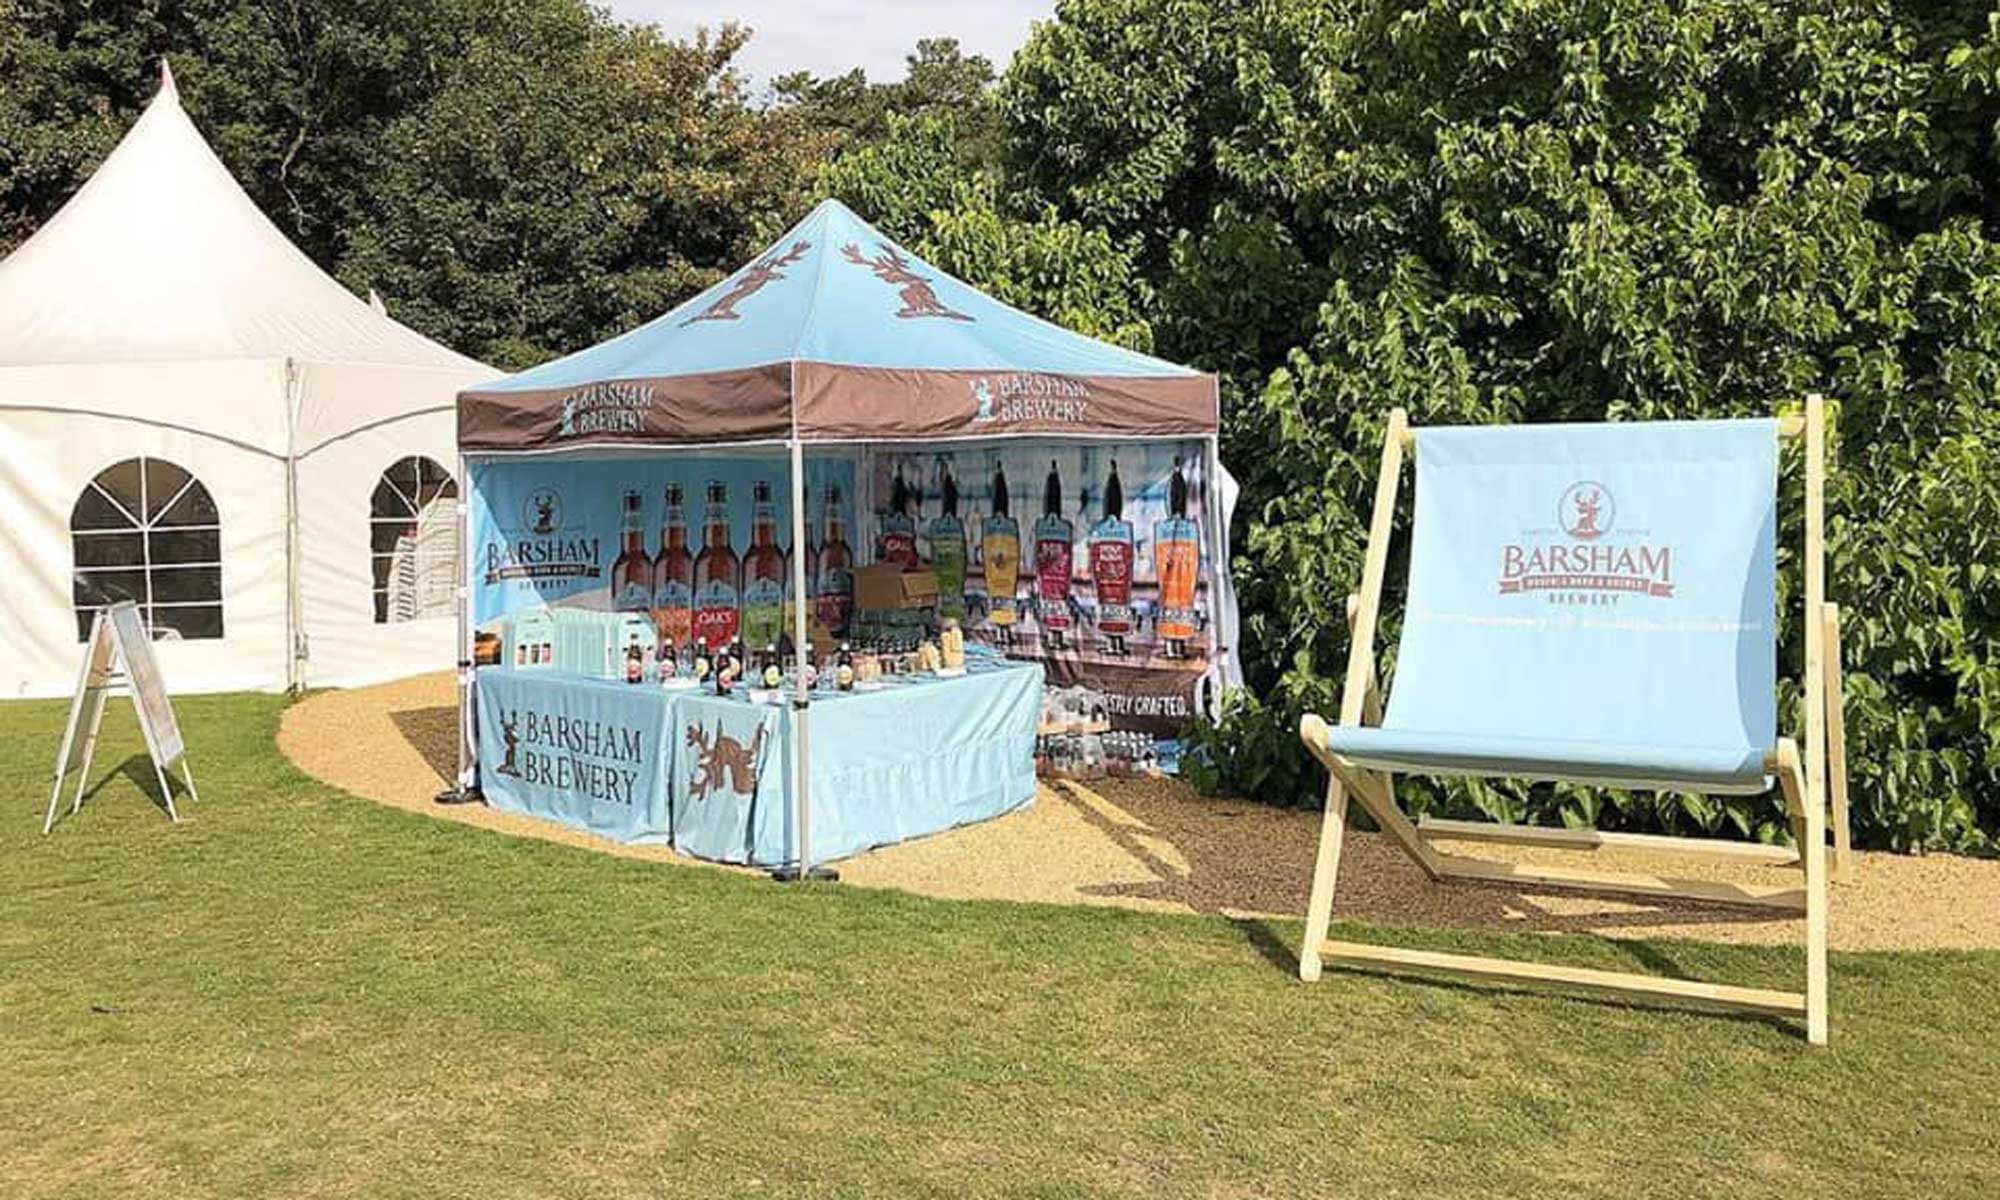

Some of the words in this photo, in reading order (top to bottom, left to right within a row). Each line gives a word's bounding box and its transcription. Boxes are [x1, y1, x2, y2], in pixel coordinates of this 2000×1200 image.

[580, 383, 654, 409] BARSHAM
[1000, 399, 1087, 421] BREWERY
[580, 410, 649, 434] BREWERY
[487, 537, 600, 571] BARSHAM
[1503, 545, 1670, 581] BARSHAM
[526, 710, 642, 764] BARSHAM
[525, 751, 637, 805] BREWERY
